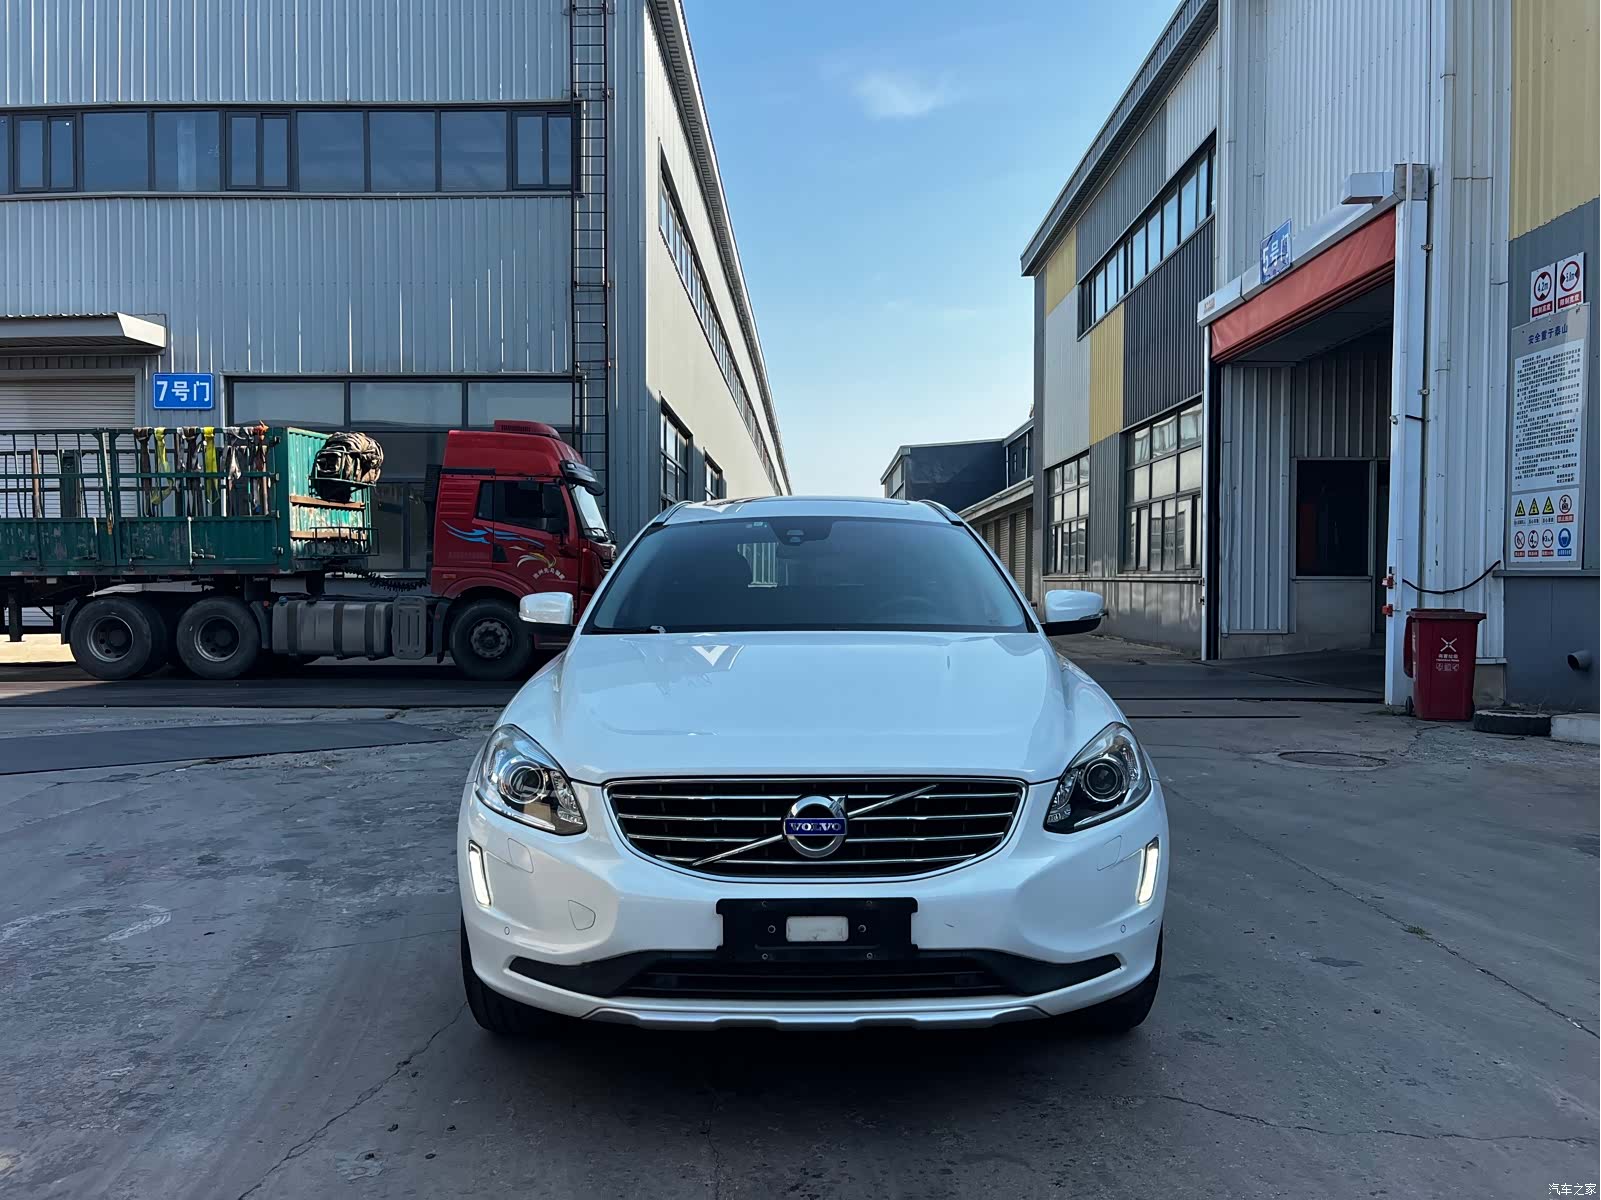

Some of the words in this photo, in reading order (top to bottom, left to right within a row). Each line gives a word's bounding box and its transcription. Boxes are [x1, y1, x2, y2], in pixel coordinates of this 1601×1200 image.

[1262, 232, 1290, 275] 5号门
[156, 380, 210, 402] 7号门
[789, 823, 842, 831] VOLVO
